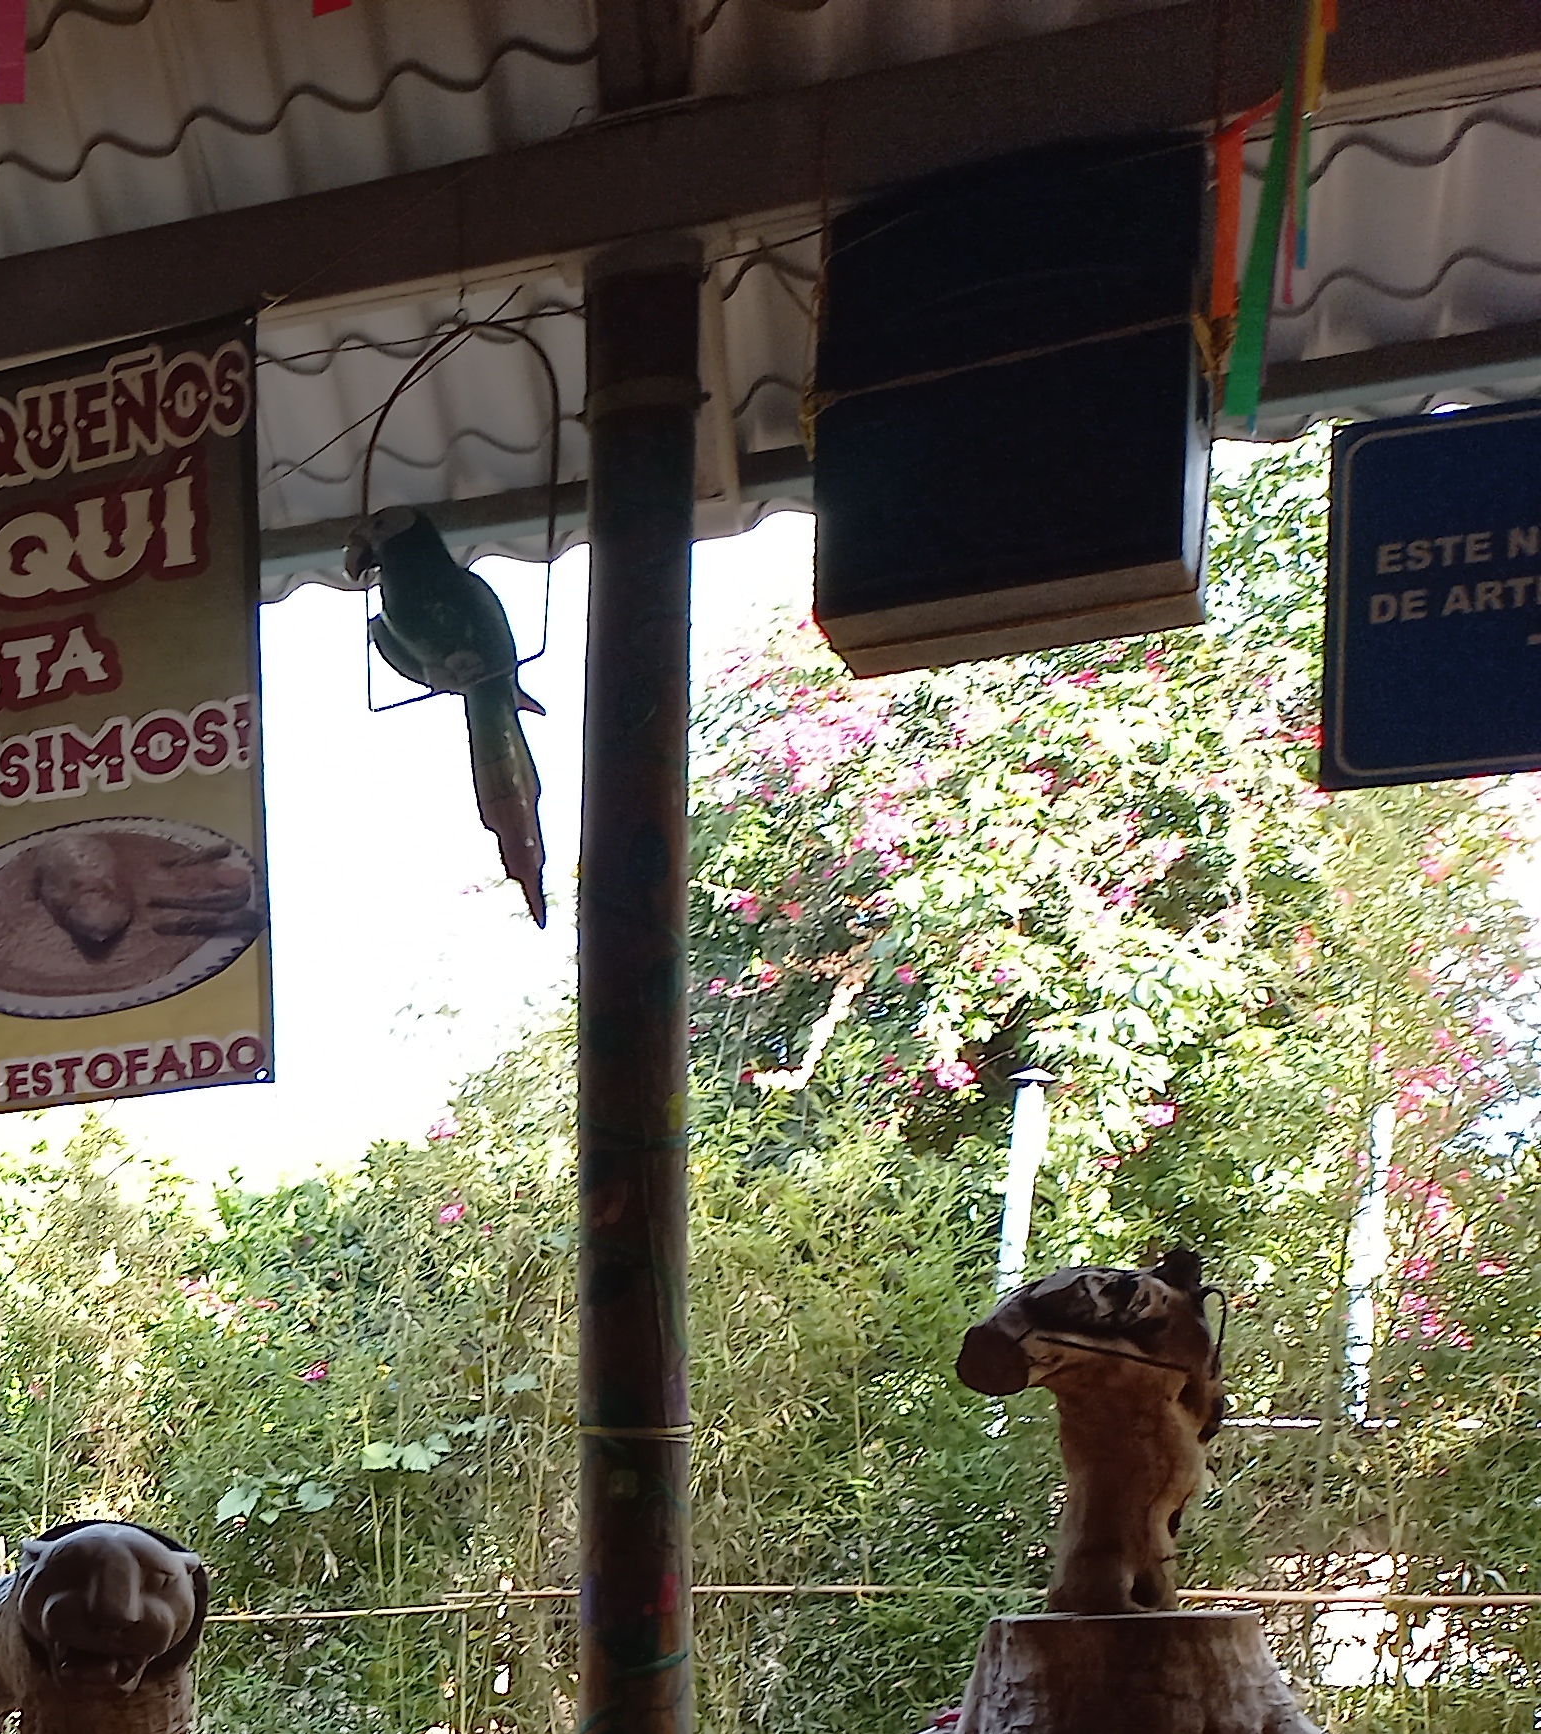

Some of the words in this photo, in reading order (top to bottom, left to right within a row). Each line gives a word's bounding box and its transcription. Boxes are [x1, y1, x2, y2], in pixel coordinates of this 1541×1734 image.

[1375, 531, 1493, 576] ESTE
[1369, 588, 1429, 625] DE
[1440, 575, 1541, 617] ART
[5, 1035, 265, 1102] ESTOFADO
